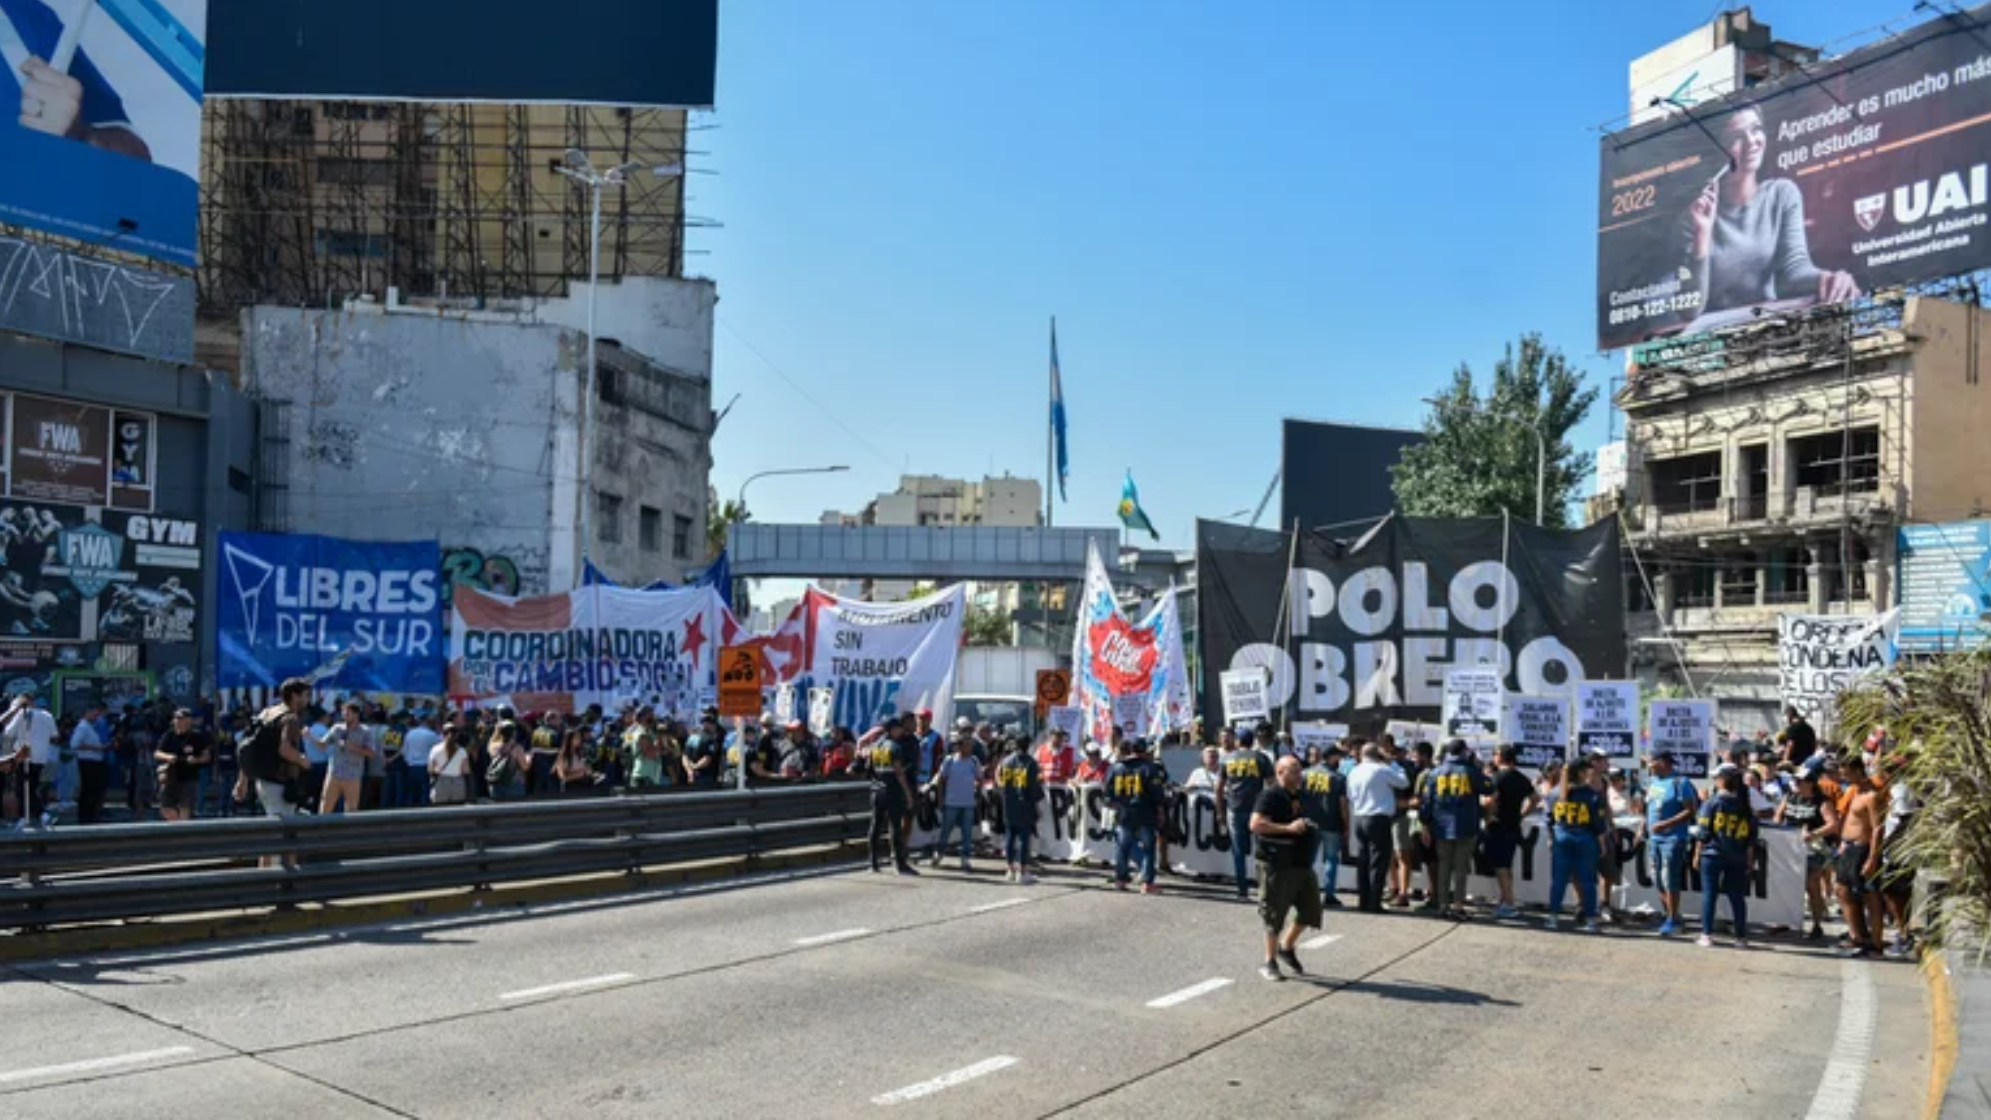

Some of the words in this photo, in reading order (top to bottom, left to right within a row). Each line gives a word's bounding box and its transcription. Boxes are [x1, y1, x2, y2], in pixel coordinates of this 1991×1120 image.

[1777, 101, 1854, 141] Aprender
[1858, 95, 1880, 117] es
[1884, 72, 1949, 108] mucho
[1777, 144, 1808, 171] que
[1812, 121, 1882, 158] estudiar
[1612, 184, 1655, 217] 2022
[1893, 163, 1988, 223] UAI
[1852, 224, 1933, 255] Universidad
[1935, 212, 1988, 236] Abierta
[1866, 233, 1970, 267] Interamericana
[40, 421, 81, 454] FWA
[127, 515, 197, 546] GYM
[67, 533, 114, 568] FWA
[275, 565, 437, 613] LIBRES
[1290, 560, 1520, 637] POLO
[276, 612, 340, 651] DEL
[351, 618, 432, 656] SUR
[464, 627, 678, 662] COORDINADORA
[833, 629, 863, 650] SIN
[494, 659, 614, 692] CAMBIO
[831, 656, 908, 678] TRABAJO
[1113, 773, 1144, 796] PFA
[1226, 758, 1260, 778] PFA
[1306, 770, 1331, 793] PFA
[1437, 773, 1472, 796] PFA
[1552, 801, 1590, 825] PFA
[1712, 811, 1749, 840] PFA
